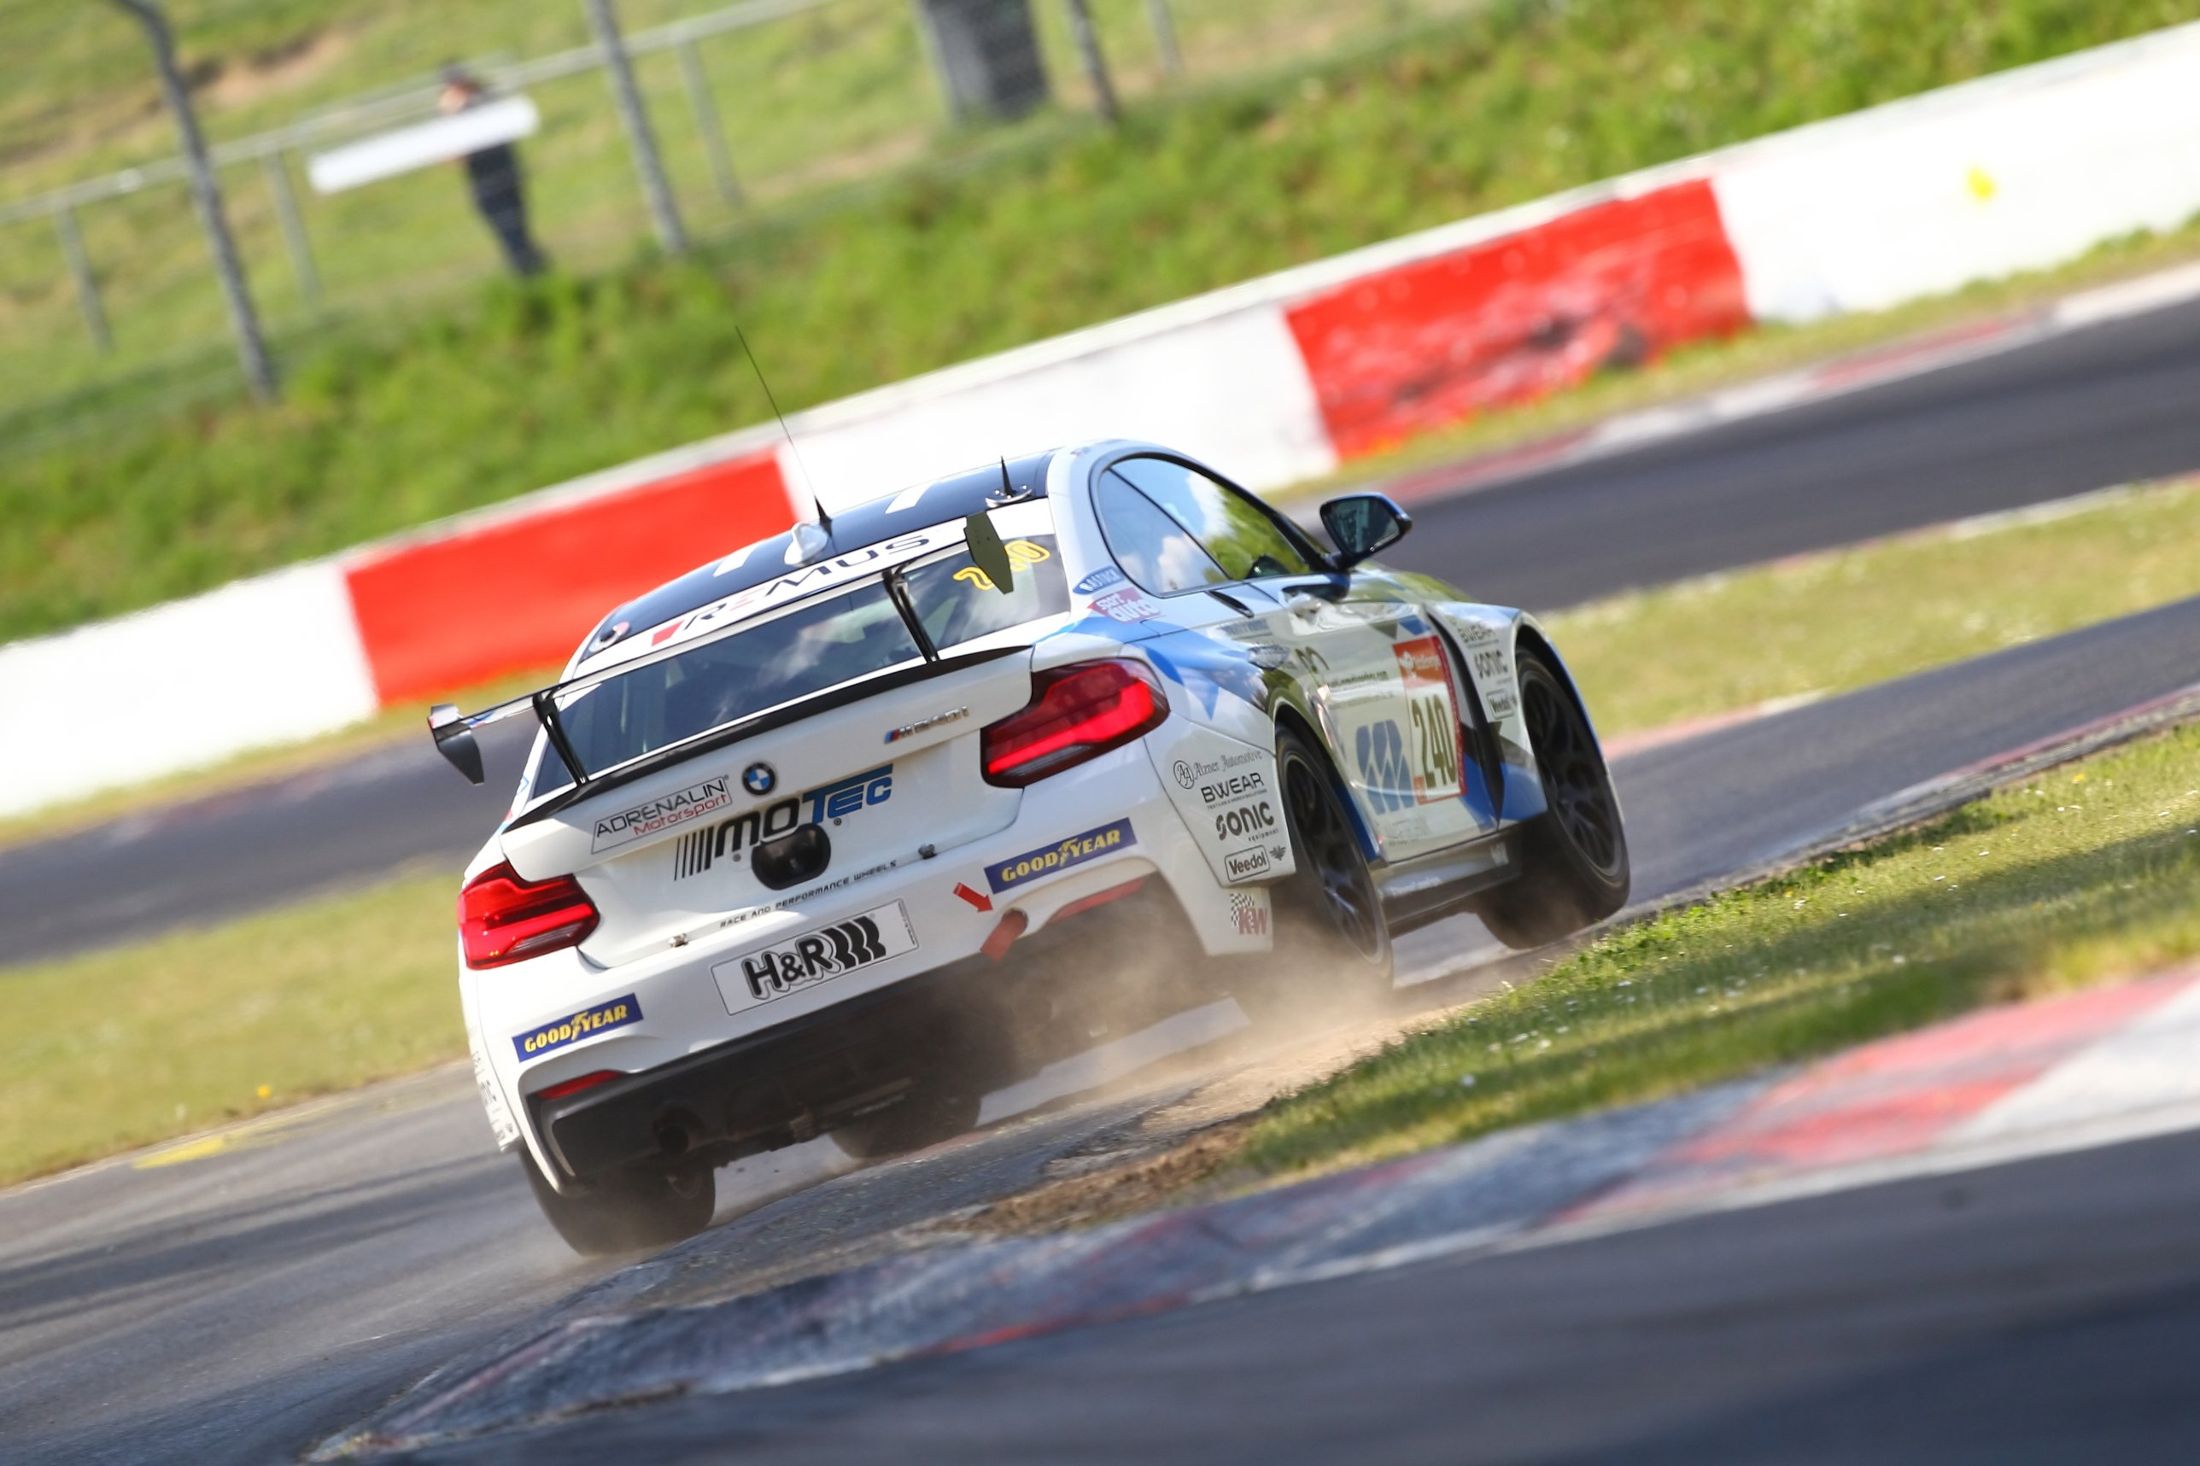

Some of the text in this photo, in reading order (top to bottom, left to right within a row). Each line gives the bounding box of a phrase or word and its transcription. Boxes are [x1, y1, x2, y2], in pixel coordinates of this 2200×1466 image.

[684, 534, 930, 630] REMUS
[953, 540, 1050, 590] 20
[1107, 599, 1160, 622] auto
[1412, 694, 1456, 788] 240
[597, 779, 724, 838] ADRENALIN
[1201, 772, 1264, 804] BWEAR
[633, 794, 727, 836] Motorsport
[1002, 829, 1121, 882] GOODYEAR
[1228, 851, 1267, 875] Veedol
[720, 914, 747, 929] RACE
[775, 877, 849, 910] PERFORMANCE
[853, 859, 897, 881] WHEELS
[1239, 908, 1267, 935] KW
[743, 937, 833, 996] H&R
[524, 1004, 628, 1053] GOODYEAR
